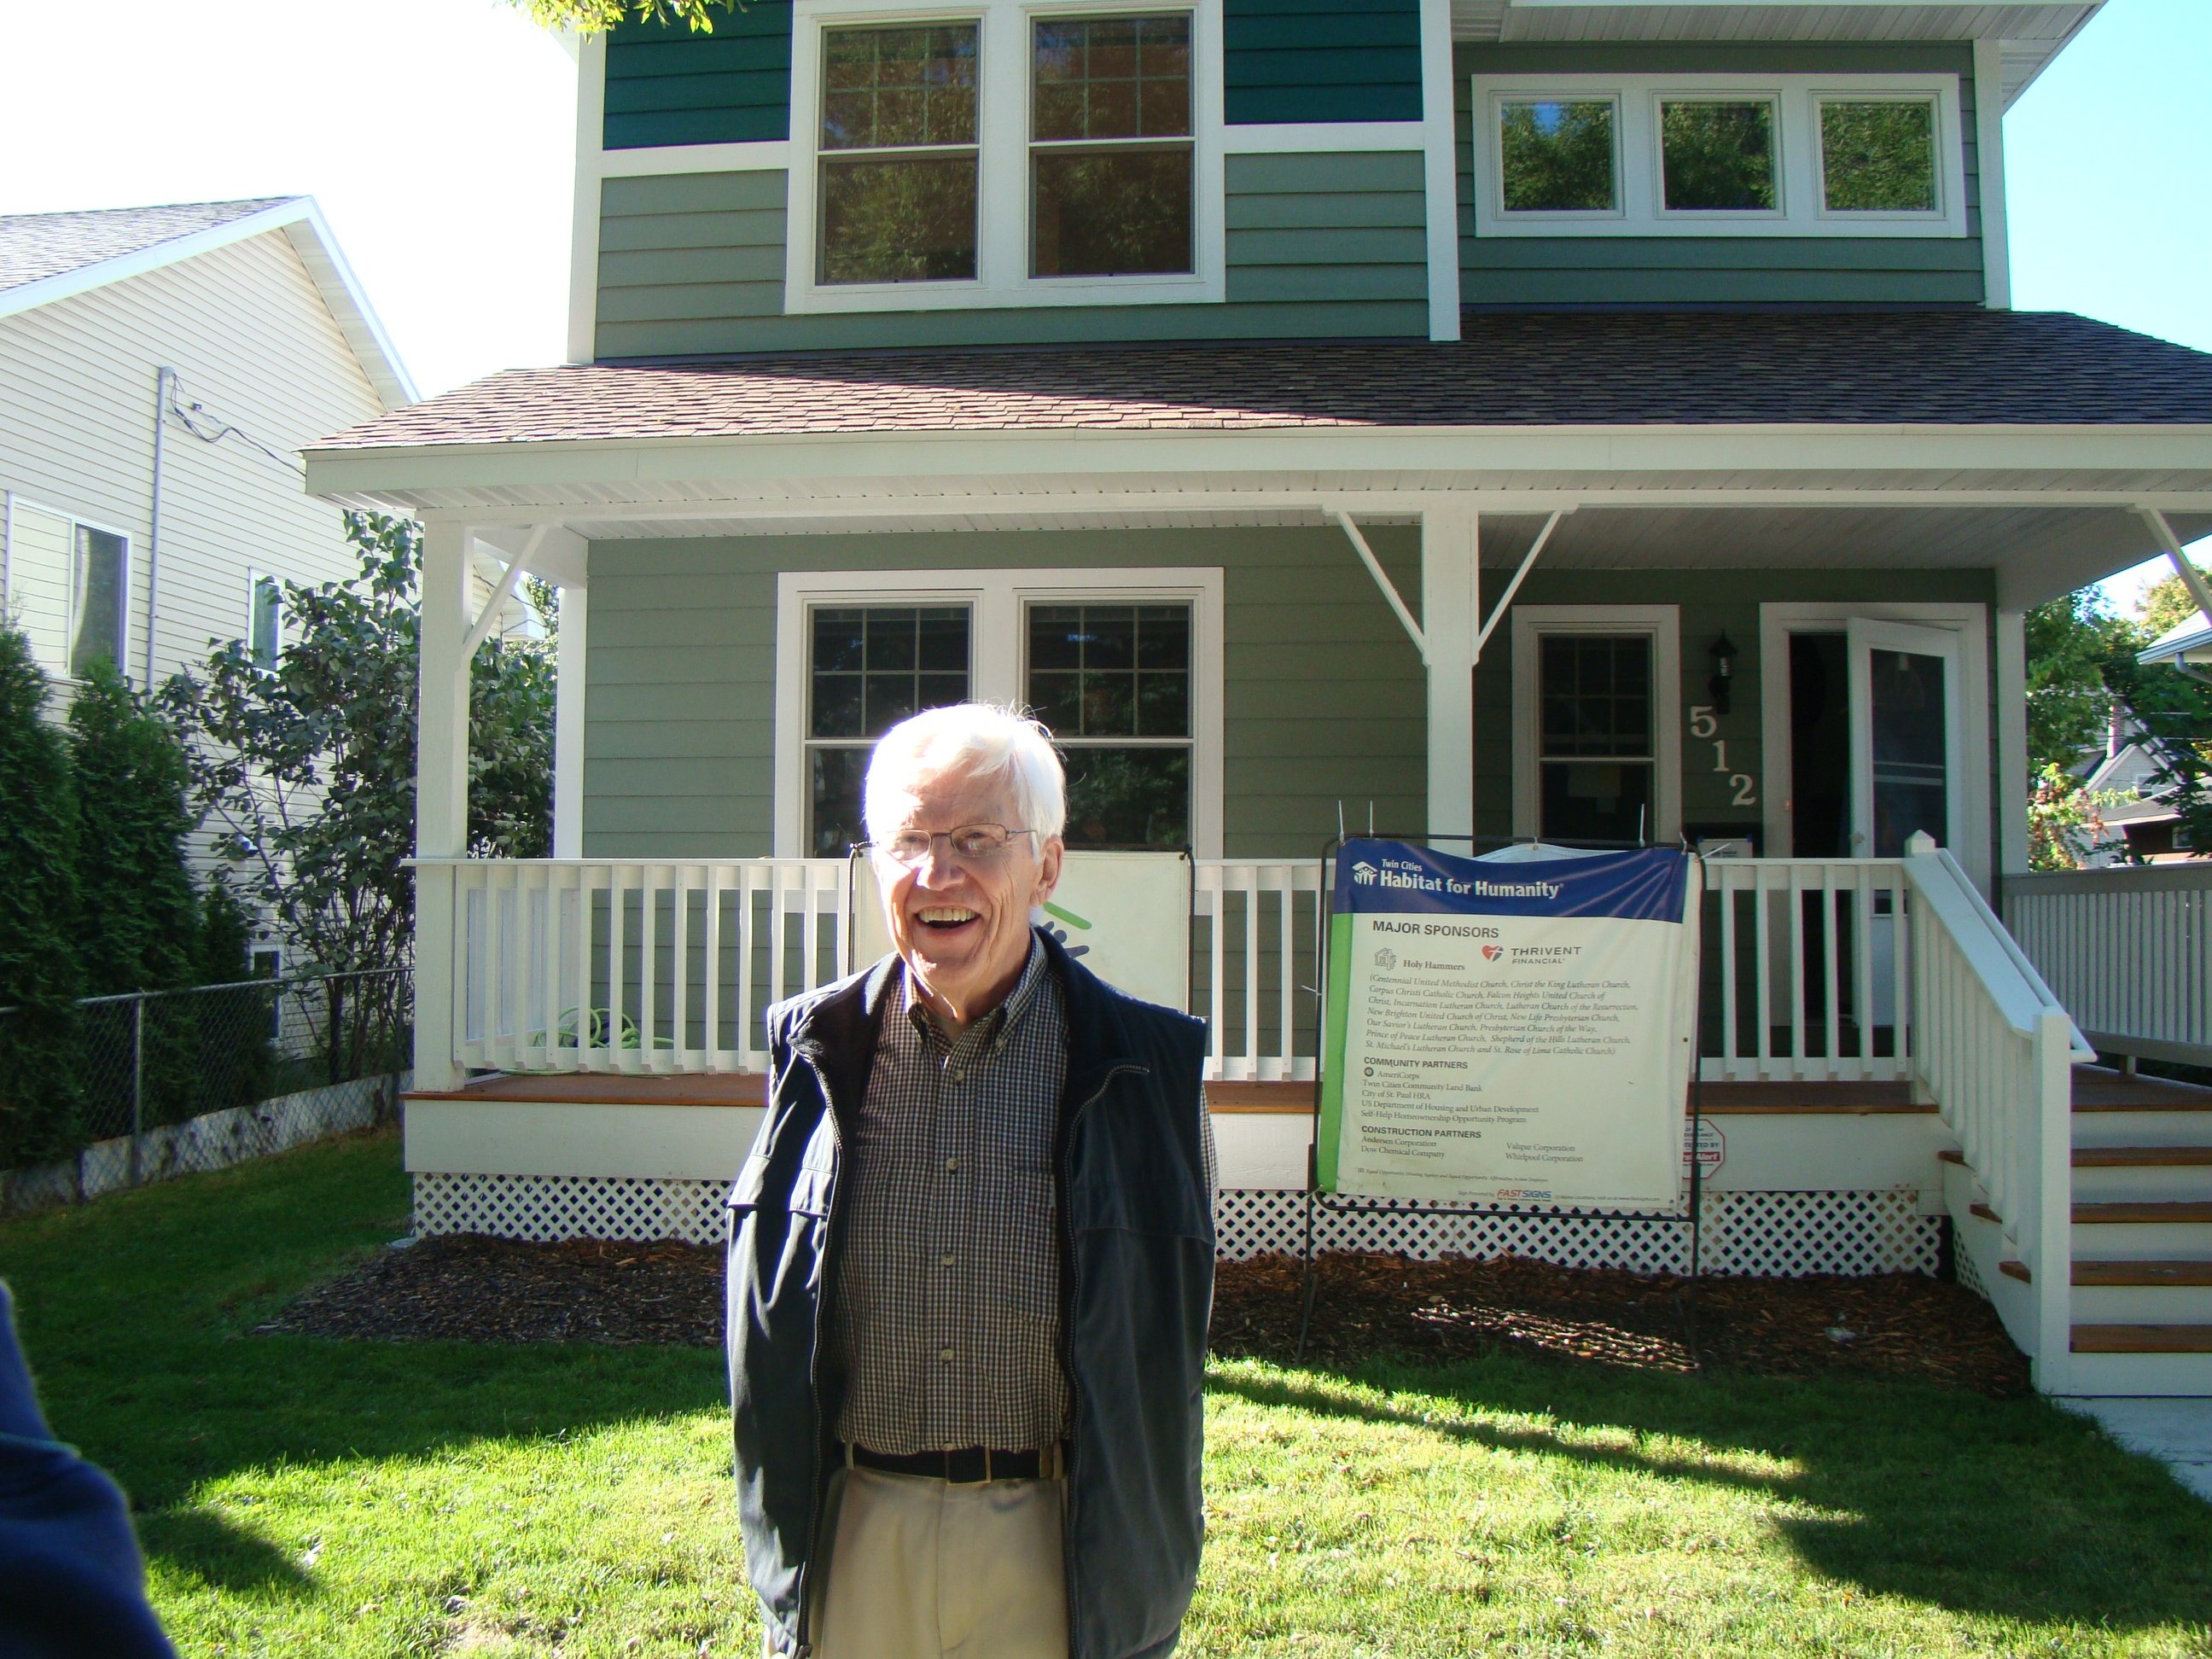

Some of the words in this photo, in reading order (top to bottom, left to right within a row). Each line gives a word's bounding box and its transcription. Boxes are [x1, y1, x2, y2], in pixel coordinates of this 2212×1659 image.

[1382, 859, 1400, 870] Twin
[1401, 860, 1423, 871] Cities
[1380, 870, 1442, 893] Habitat
[1446, 878, 1470, 894] for
[1476, 881, 1560, 899] Humanity
[1372, 920, 1420, 934] MAJOR
[1423, 923, 1499, 939] SPONSORS
[1511, 946, 1581, 957] THRIVENT
[1403, 959, 1423, 969] Holy
[1425, 961, 1465, 971] Hammers
[1414, 978, 1439, 987] United
[1547, 981, 1565, 990] King
[1369, 985, 1394, 996] Corpus
[1395, 987, 1421, 996] Christi
[1423, 989, 1454, 998] Catholic
[1513, 992, 1540, 1000] Heights
[1597, 992, 1606, 1001] of
[1394, 998, 1437, 1008] Incarnation
[1439, 1001, 1473, 1010] Lutheran
[1570, 1003, 1580, 1012] of
[1385, 1009, 1417, 1020] Brighton
[1419, 1011, 1444, 1020] United
[1447, 1012, 1474, 1021] Church
[1475, 1012, 1482, 1022] of
[1544, 1014, 1589, 1022] Presbyterian
[1383, 1020, 1411, 1028] Savior's
[1413, 1022, 1447, 1031] Lutheran
[1480, 1024, 1525, 1033] Presbyterian
[1527, 1024, 1555, 1033] Church
[1556, 1024, 1565, 1034] of
[1565, 1024, 1576, 1033] the
[1366, 1028, 1388, 1038] Prince
[1390, 1030, 1399, 1041] of
[1400, 1031, 1420, 1039] Peace
[1423, 1032, 1456, 1041] Lutheran
[1491, 1034, 1524, 1044] Shepherd
[1526, 1034, 1535, 1045] of
[1567, 1035, 1601, 1044] Lutheran
[1377, 1041, 1411, 1051] Michael's
[1412, 1043, 1447, 1052] Lutheran
[1523, 1045, 1532, 1057] of
[1364, 1057, 1420, 1068] COMMUNITY
[1423, 1061, 1468, 1069] PARTNERS
[1377, 1071, 1419, 1080] AmeriCorps
[1382, 1080, 1401, 1089] Cities
[1403, 1082, 1444, 1091] Community
[1447, 1083, 1464, 1091] Land
[1362, 1090, 1376, 1098] City
[1374, 1101, 1414, 1110] Department
[1425, 1103, 1453, 1113] Housing
[1493, 1106, 1540, 1115] Development
[1361, 1109, 1393, 1120] Self-Help
[1394, 1113, 1451, 1123] Homeownership
[1452, 1115, 1495, 1124] Opportunity
[1362, 1126, 1432, 1137] CONSTRUCTION
[1435, 1130, 1481, 1138] PARTNERS
[1362, 1136, 1393, 1145] Andersen
[1394, 1138, 1437, 1149] Corporation
[1506, 1142, 1532, 1151] Valspar
[1534, 1143, 1575, 1153] Corporation
[1379, 1147, 1410, 1155] Chemical
[1412, 1150, 1445, 1159] Company
[1505, 1153, 1540, 1162] Whirlpool
[1541, 1154, 1583, 1163] Corporation
[1497, 1189, 1551, 1198] FASTSIGNS
